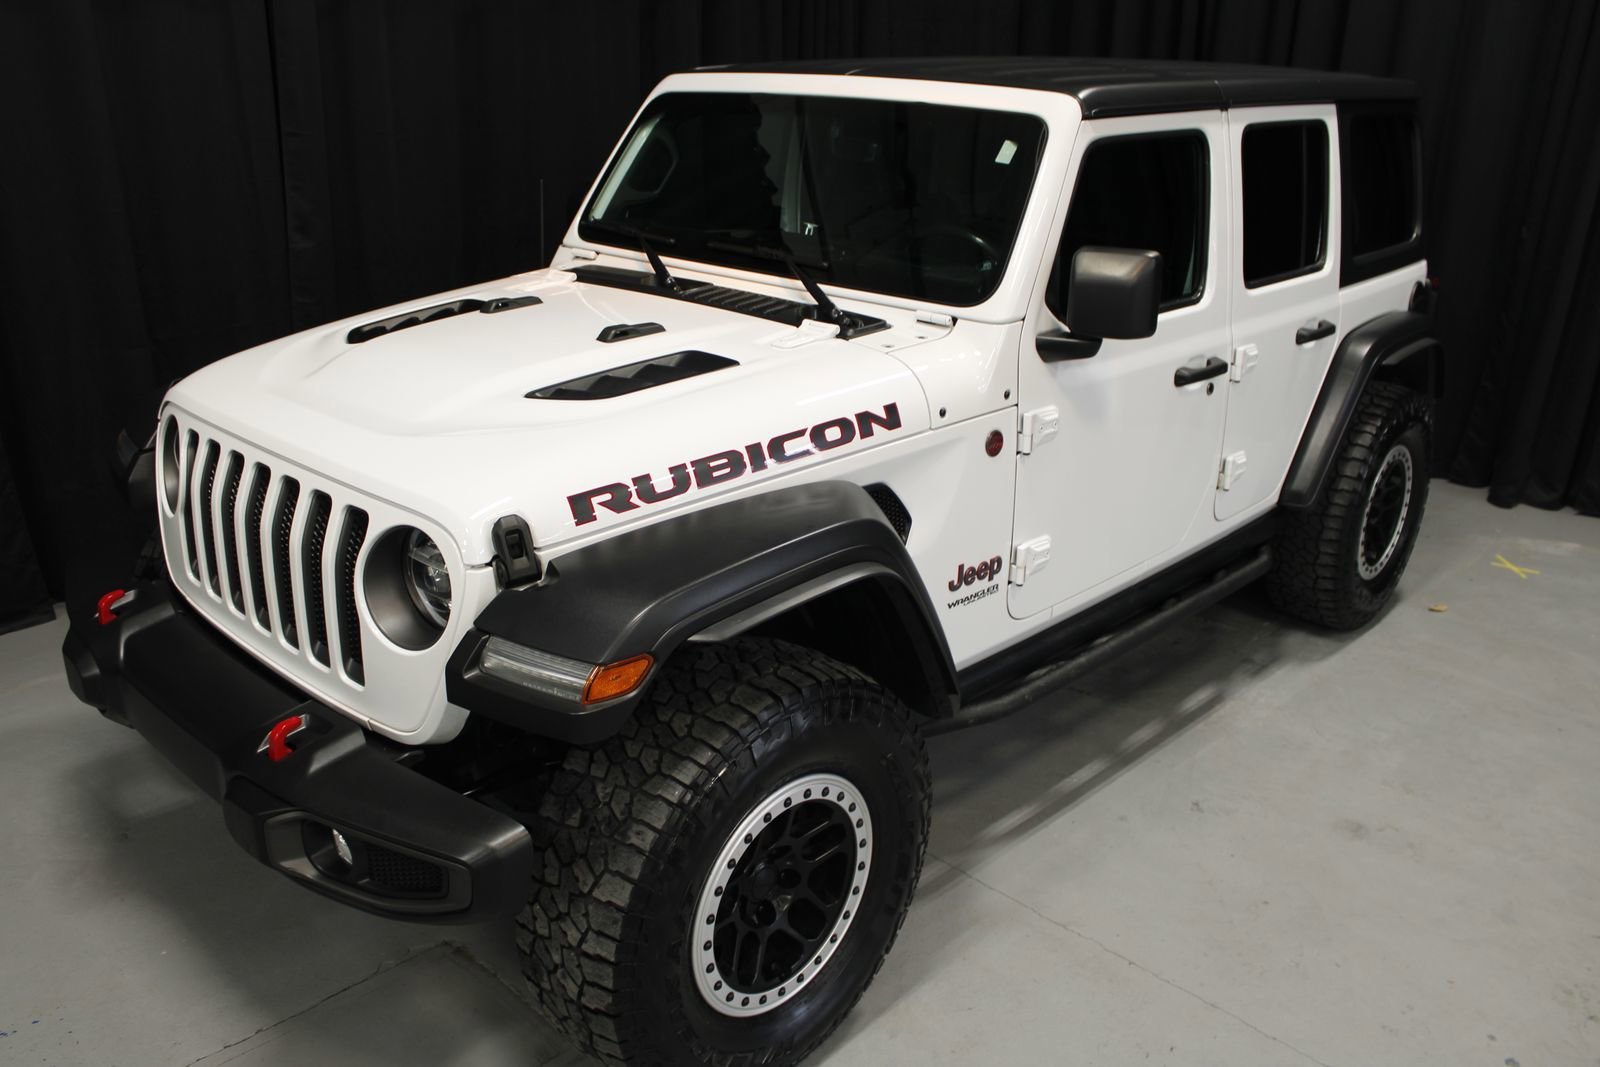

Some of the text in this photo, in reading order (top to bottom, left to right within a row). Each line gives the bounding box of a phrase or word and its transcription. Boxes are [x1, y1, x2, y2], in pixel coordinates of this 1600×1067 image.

[566, 402, 902, 526] RUBICON
[948, 555, 1003, 592] Jeep
[947, 583, 999, 609] WRANGLER
